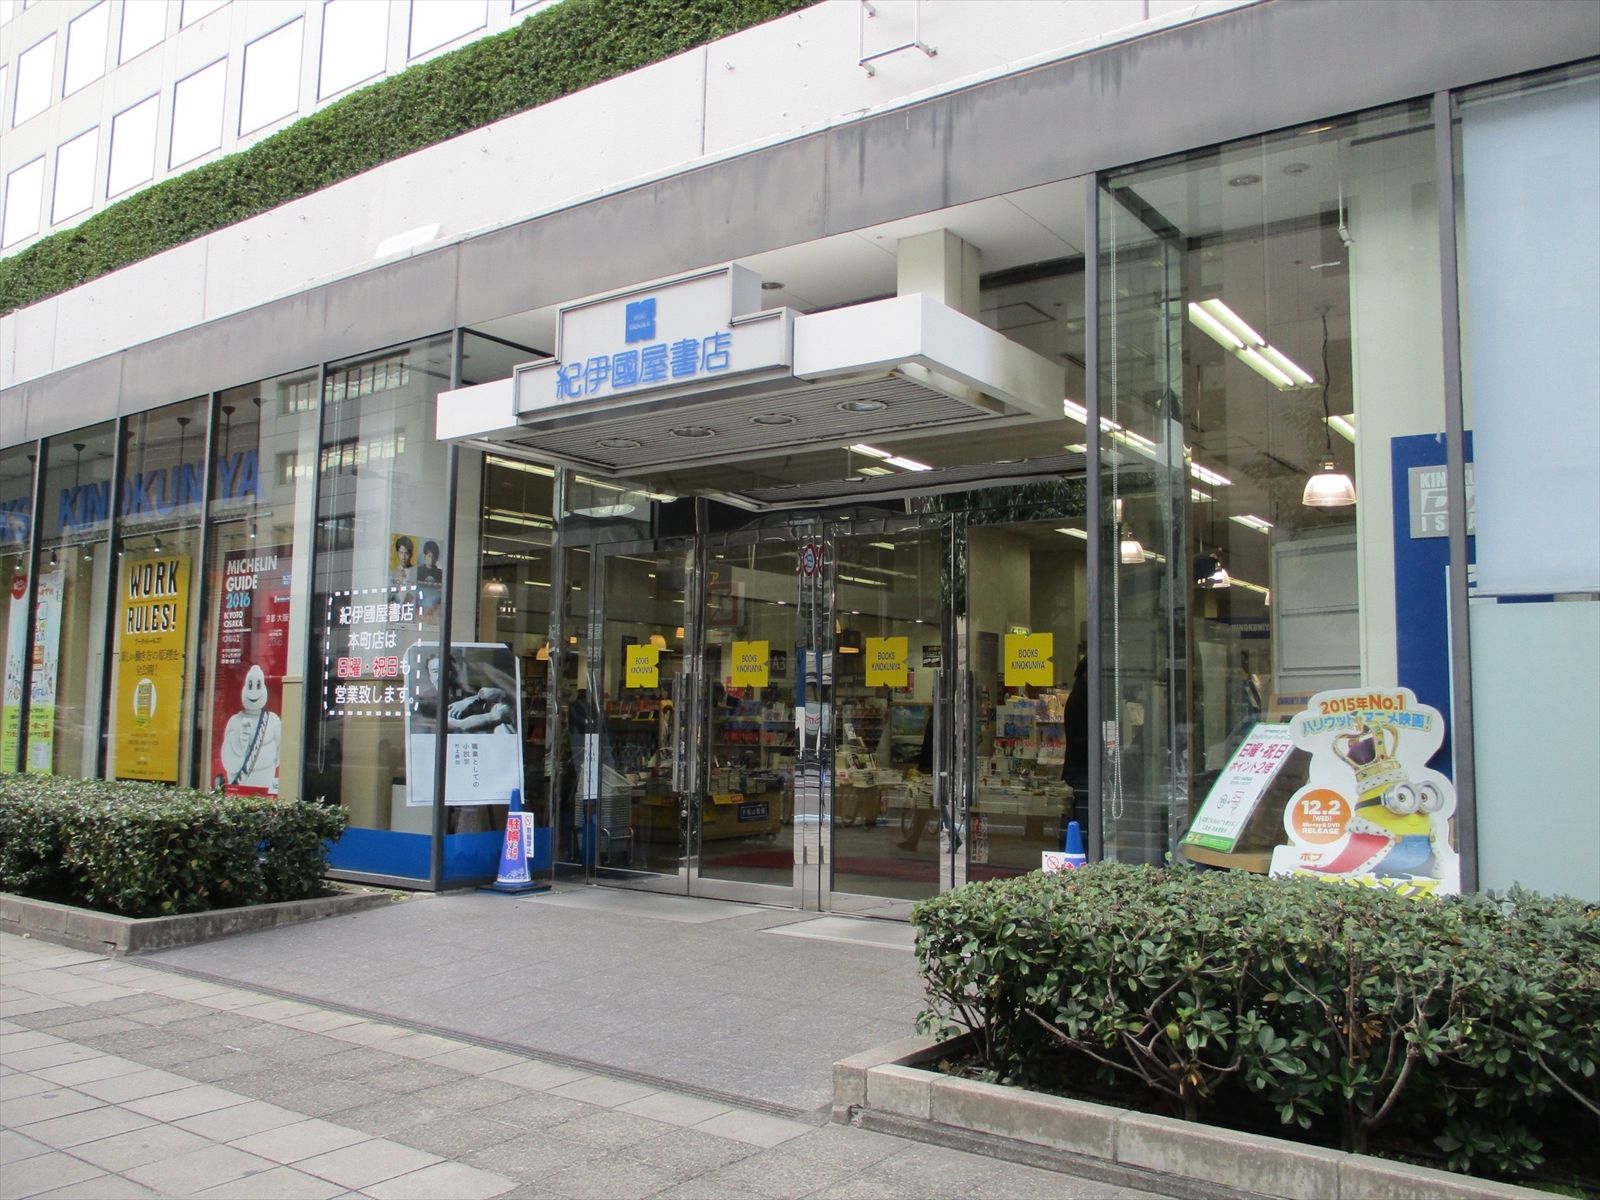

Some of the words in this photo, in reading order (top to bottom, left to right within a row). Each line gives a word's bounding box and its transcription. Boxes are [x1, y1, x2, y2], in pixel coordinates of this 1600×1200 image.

[556, 331, 732, 400] 紀伊國屋書店
[227, 555, 278, 575] MICHELIN
[129, 560, 179, 599] WORK
[226, 575, 258, 592] GUIDE
[226, 592, 251, 608] 2016
[126, 603, 177, 635] RULES!
[223, 611, 244, 620] KYOTO
[339, 602, 415, 625] 紀伊國屋書店
[223, 620, 244, 628] OSAKA
[347, 630, 398, 650] 本町店は
[741, 655, 758, 663] BOOKS
[877, 651, 896, 661] BOOKS
[1018, 649, 1039, 658] BOOKS
[337, 655, 411, 678] 日曜・祝日も
[871, 663, 901, 671] KINOKUNIYA
[1011, 661, 1046, 670] KINOKUNIYA
[335, 685, 414, 704] 営業致します。
[1319, 694, 1405, 714] 2015年No.1
[1239, 742, 1289, 759] 日曜・祝日
[1301, 800, 1341, 815] 12.2
